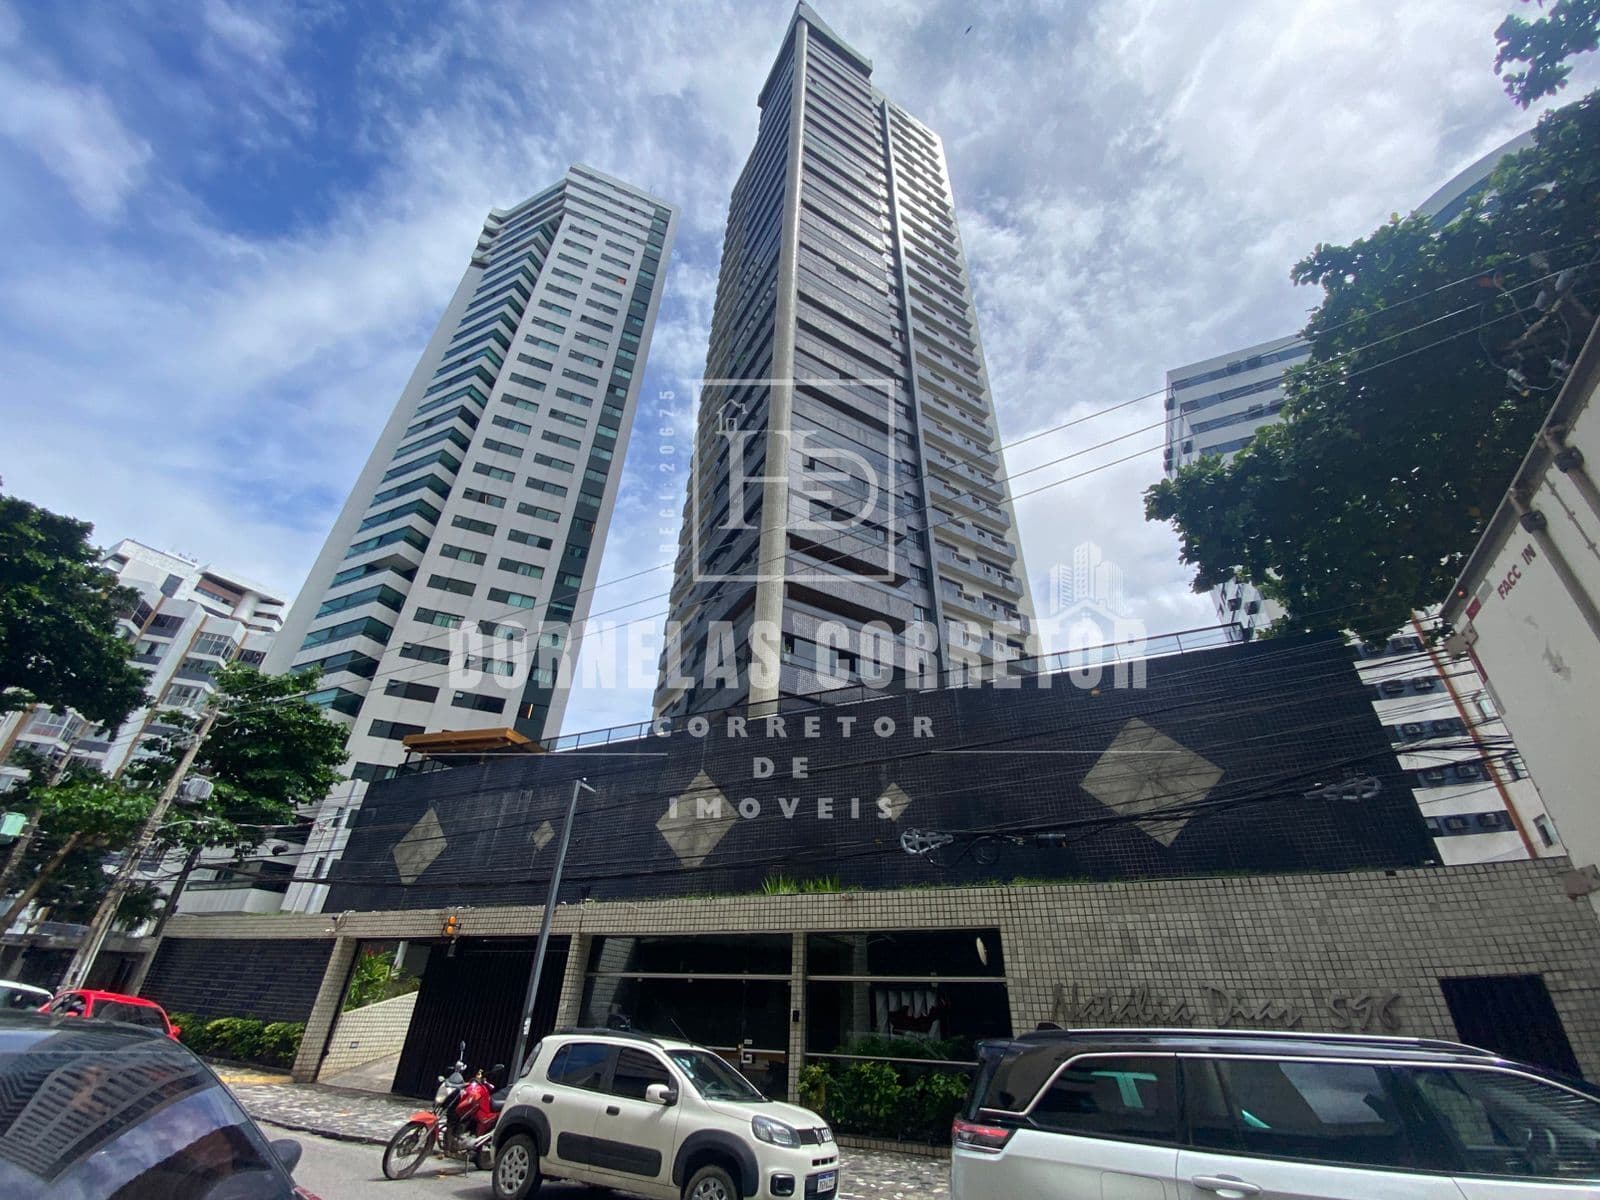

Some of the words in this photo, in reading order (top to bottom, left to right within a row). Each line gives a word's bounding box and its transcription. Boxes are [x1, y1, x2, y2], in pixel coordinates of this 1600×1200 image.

[1497, 564, 1523, 600] FACC
[1521, 543, 1537, 566] IN
[1201, 985, 1302, 1027] Dias
[1330, 991, 1402, 1031] 596
